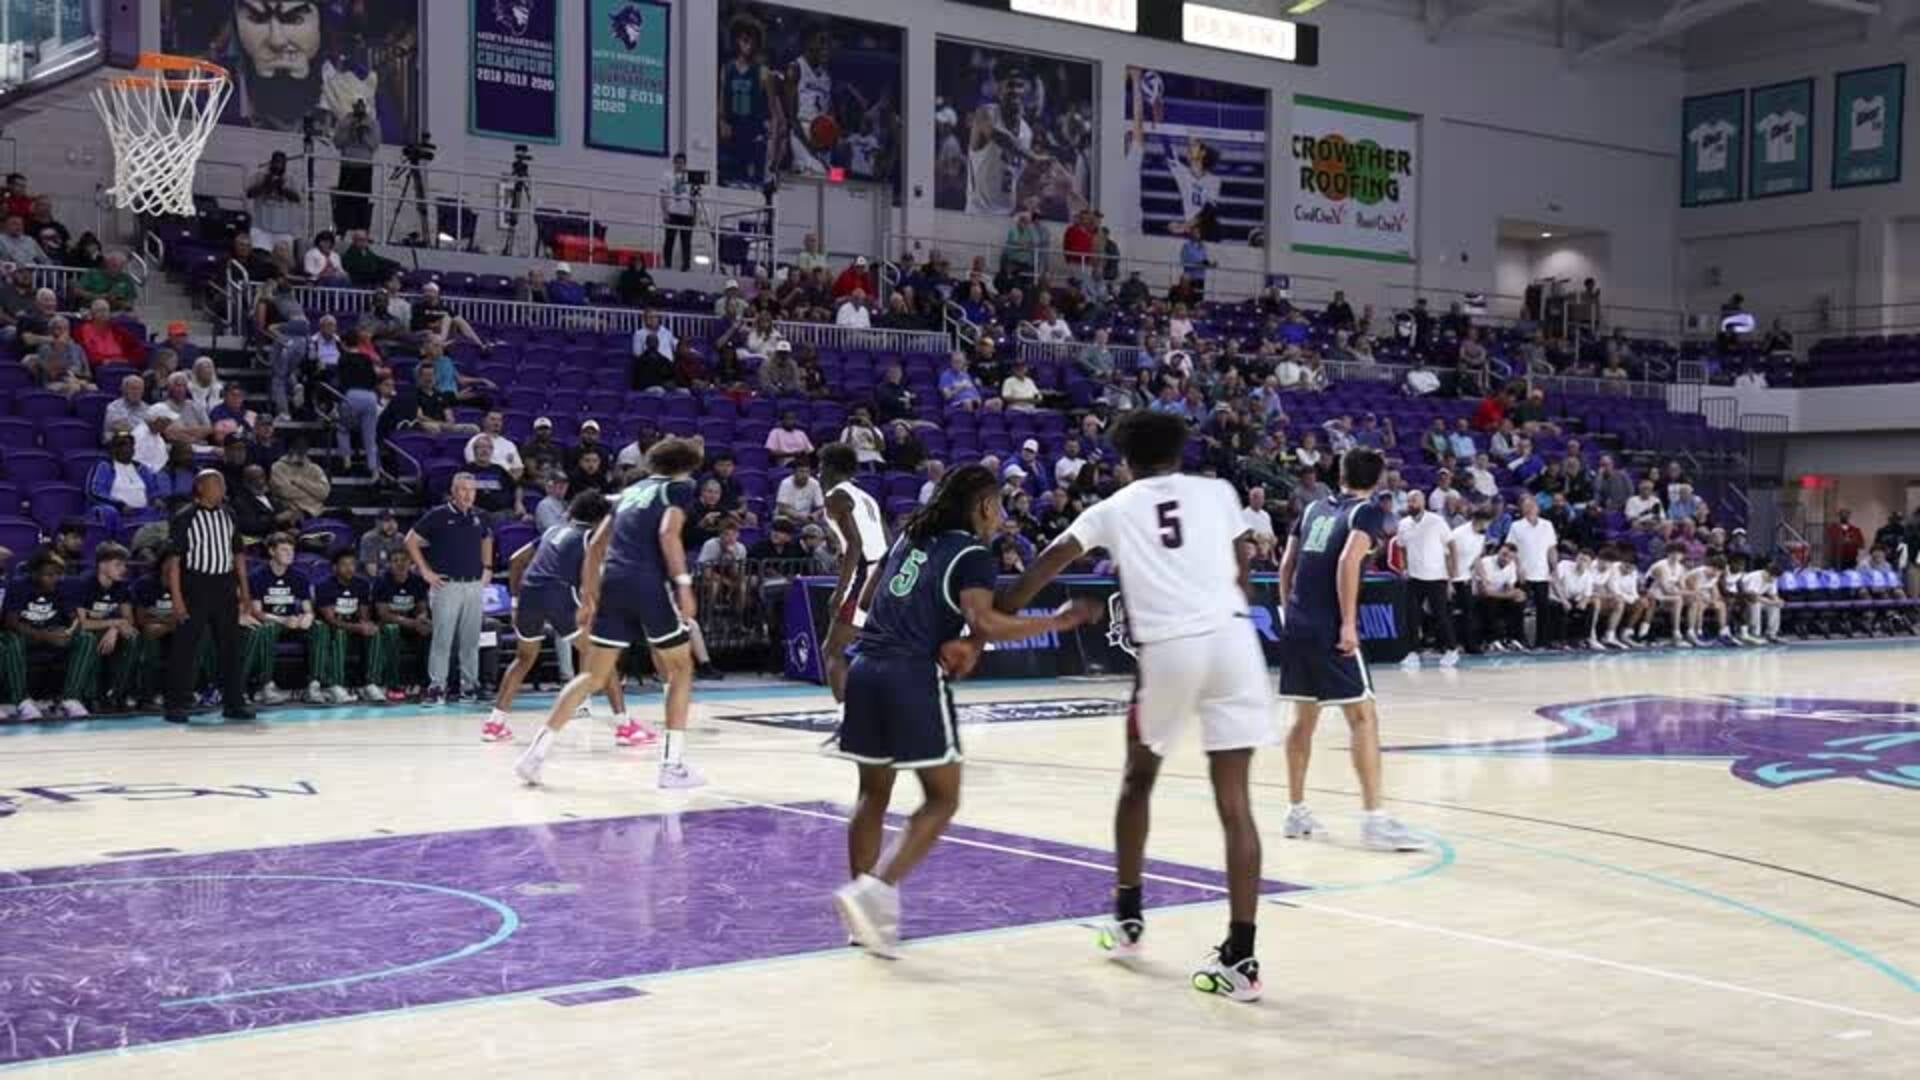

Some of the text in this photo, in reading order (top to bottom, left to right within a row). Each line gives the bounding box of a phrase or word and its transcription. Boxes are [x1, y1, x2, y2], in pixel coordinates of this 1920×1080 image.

[478, 50, 553, 75] CHAMPIONS
[531, 76, 555, 92] 2020
[591, 83, 627, 100] 2018
[591, 98, 627, 113] 2020
[1291, 135, 1412, 177] CROWTHER
[1299, 166, 1400, 203] ROOFING
[1155, 500, 1184, 550] 5
[1302, 515, 1337, 553] 11
[889, 548, 928, 597] 5
